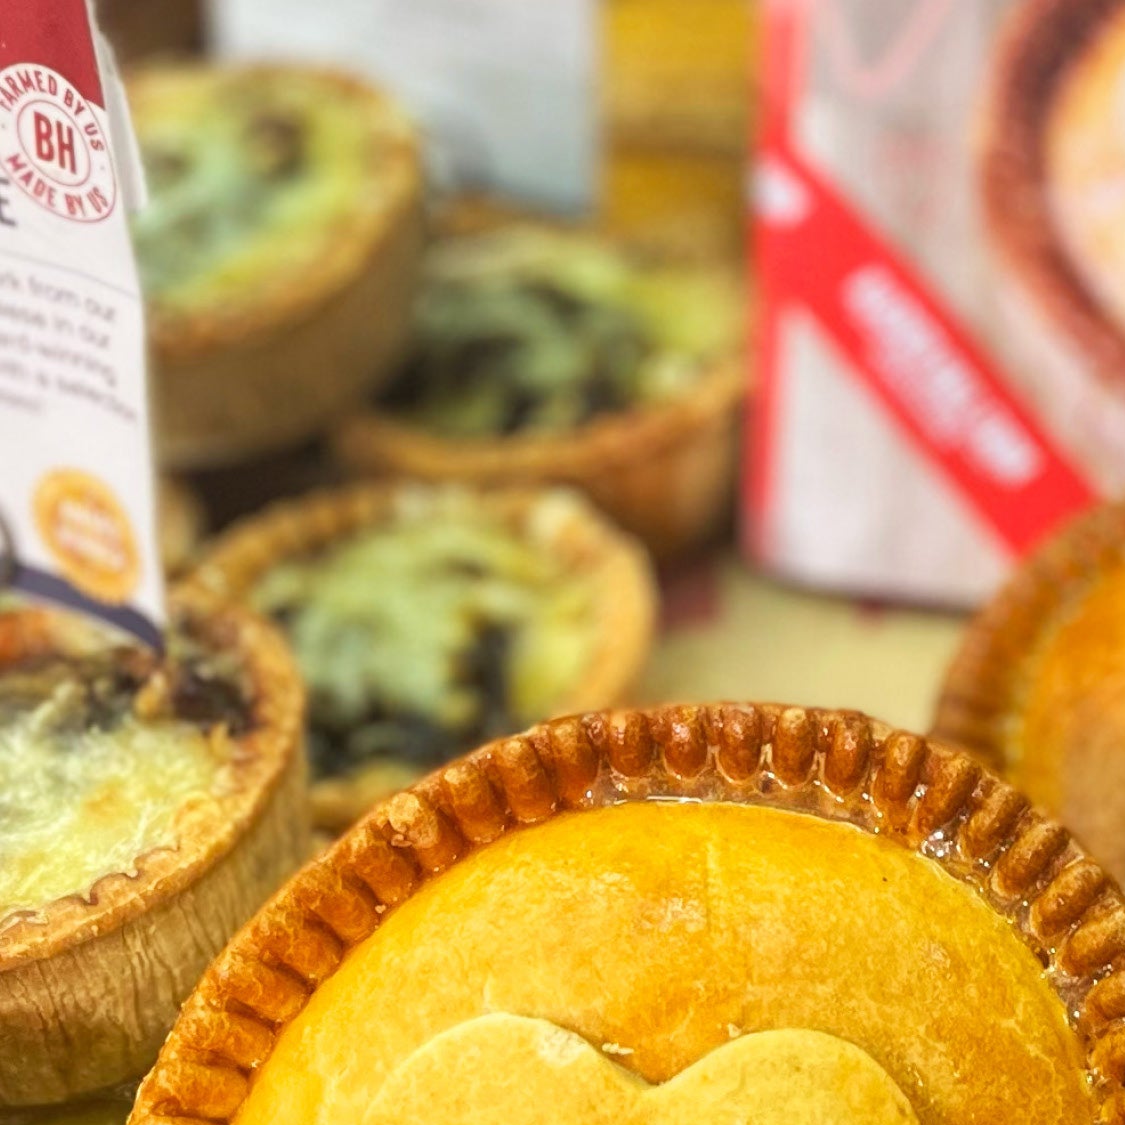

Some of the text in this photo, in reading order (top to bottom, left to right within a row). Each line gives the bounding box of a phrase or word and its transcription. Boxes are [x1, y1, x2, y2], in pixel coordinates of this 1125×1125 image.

[33, 111, 77, 175] BH
[64, 88, 85, 116] BY
[84, 123, 105, 152] US
[5, 153, 108, 218] MADE BY US
